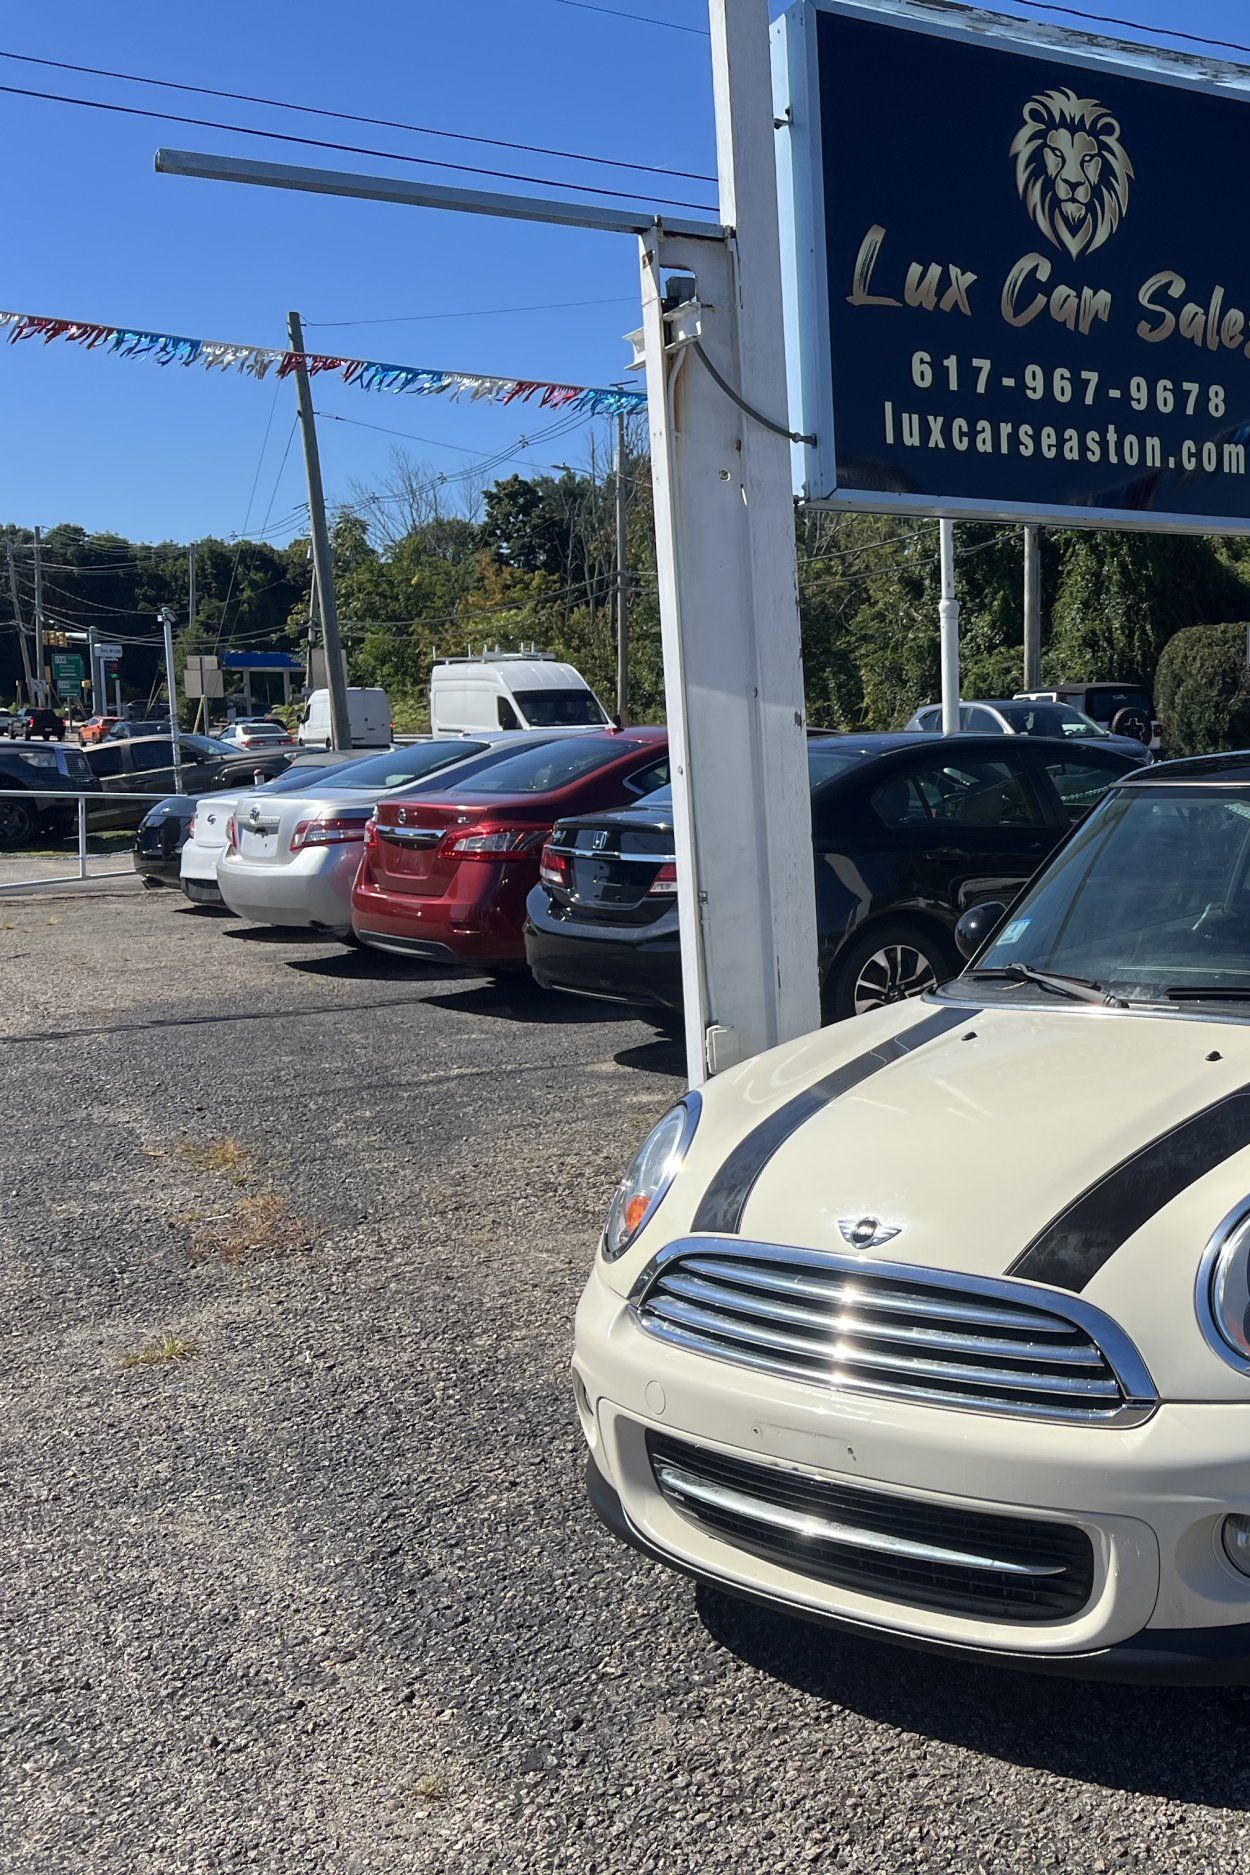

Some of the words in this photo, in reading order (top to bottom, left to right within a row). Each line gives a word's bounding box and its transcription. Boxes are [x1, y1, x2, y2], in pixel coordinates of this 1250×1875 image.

[846, 224, 978, 316] Lux
[1001, 252, 1112, 336] Car
[911, 350, 1226, 418] 617-967-9678
[884, 401, 1246, 475] luxcarseaston.com
